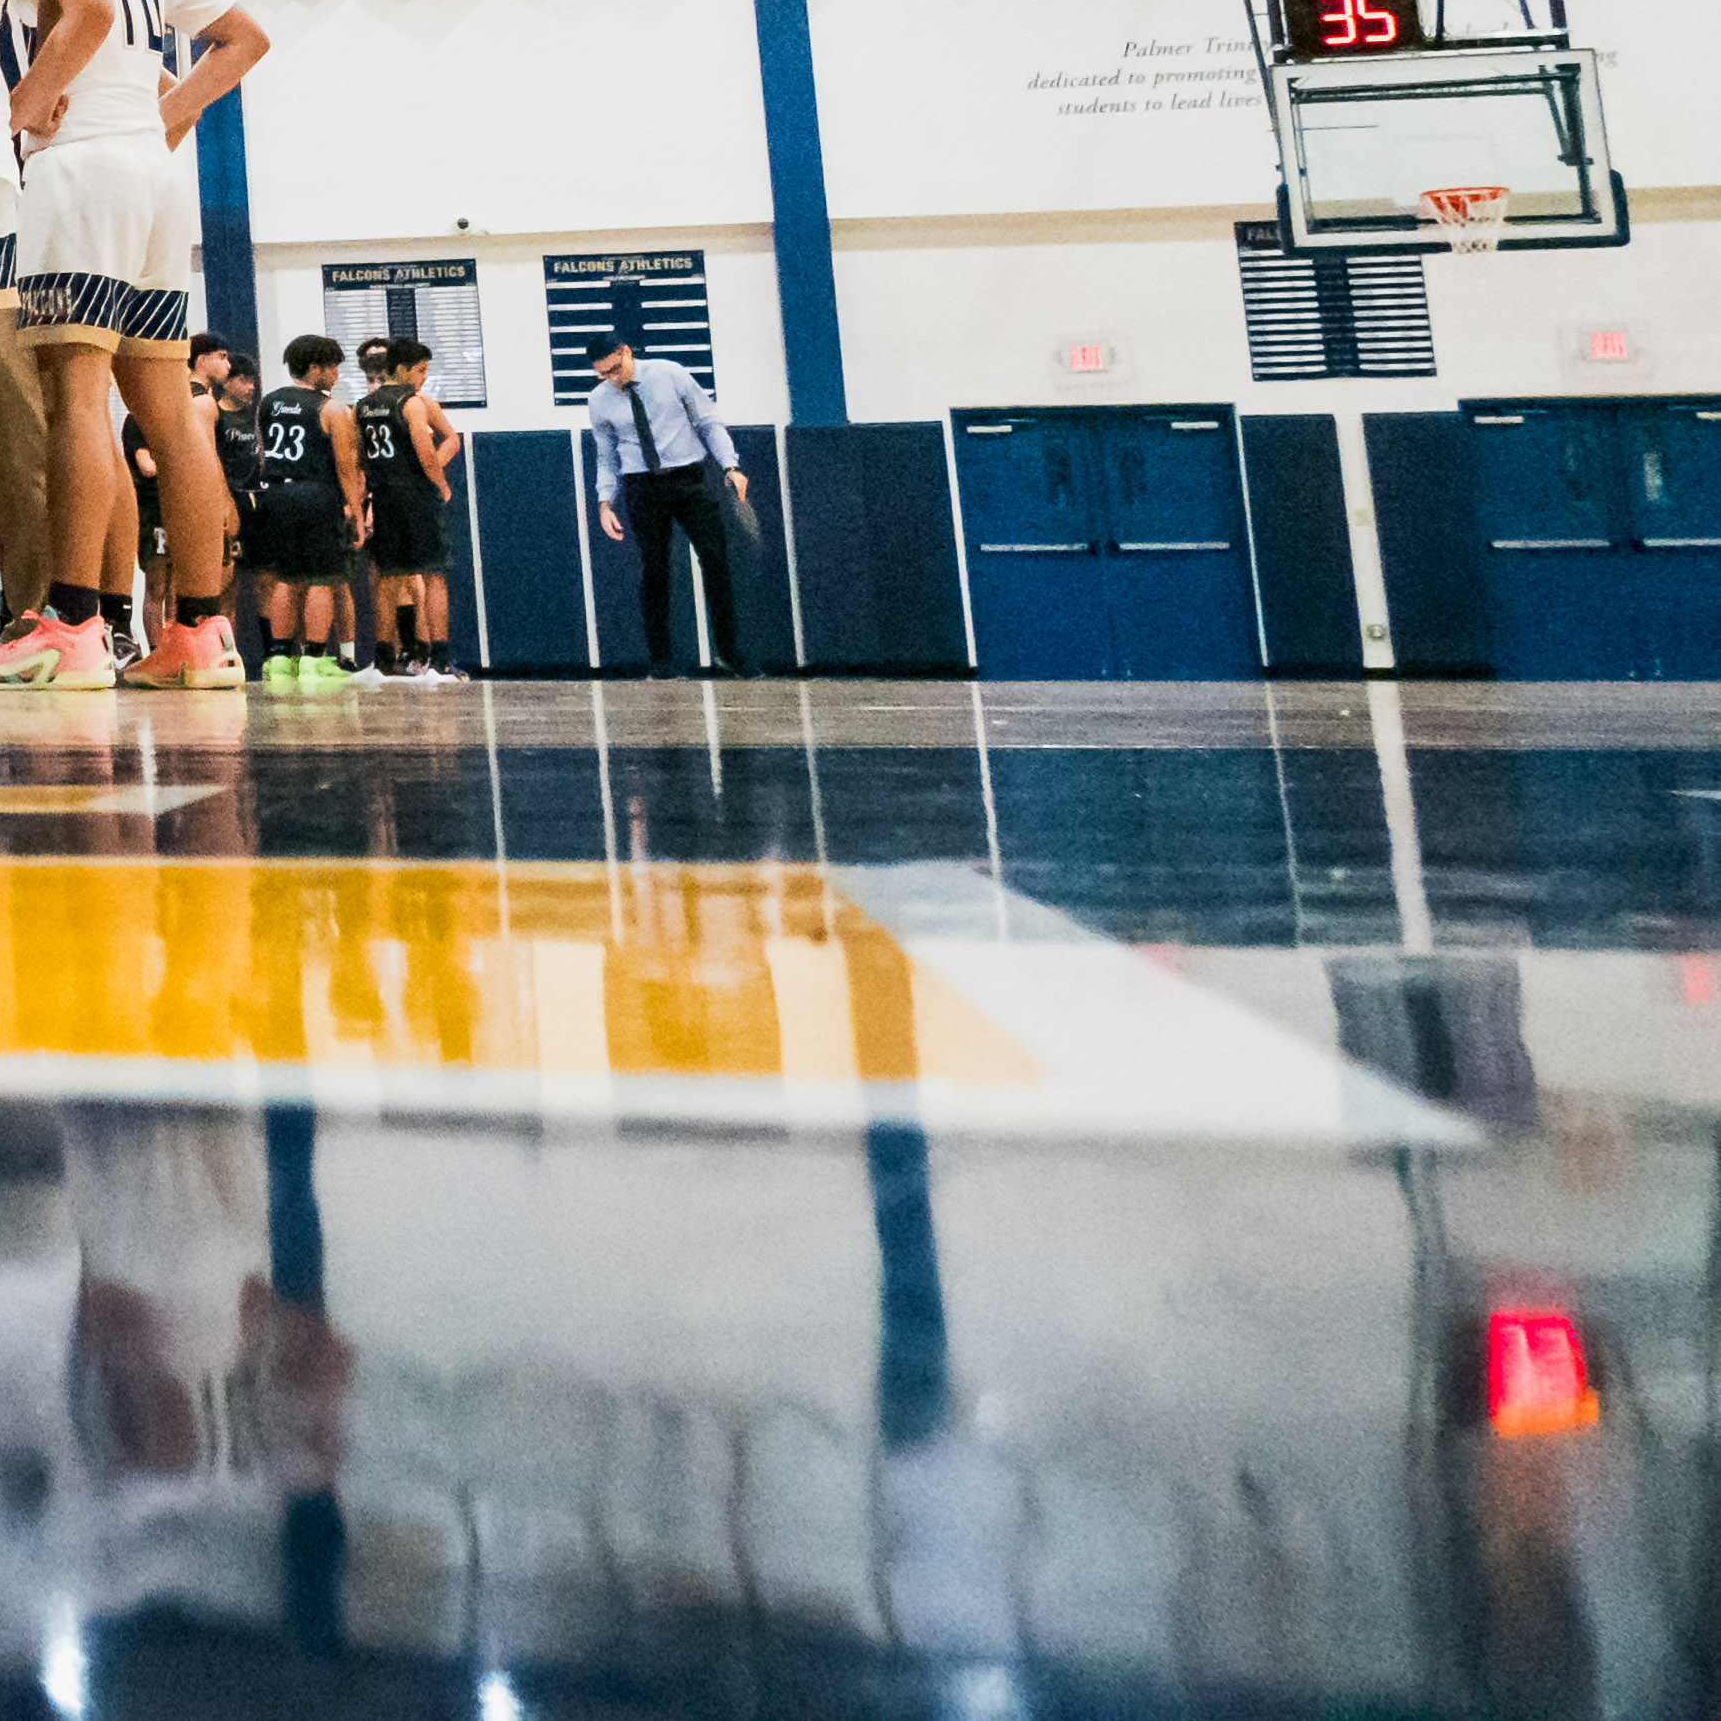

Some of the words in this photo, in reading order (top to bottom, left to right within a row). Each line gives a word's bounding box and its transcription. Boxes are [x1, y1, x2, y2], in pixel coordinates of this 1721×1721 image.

[1123, 40, 1193, 58] Palmer
[1028, 69, 1121, 90] dedicated
[1128, 74, 1146, 85] to
[1152, 68, 1258, 89] promoting
[1057, 97, 1138, 116] students
[1144, 99, 1163, 112] to
[1170, 92, 1212, 110] lead
[1219, 91, 1263, 108] lives
[332, 270, 390, 282] FALCONS
[395, 266, 466, 279] ATHLETICS
[554, 261, 614, 274] FALCONS
[620, 257, 693, 271] ATHLETICS
[265, 422, 306, 462] 23
[365, 424, 396, 459] 33
